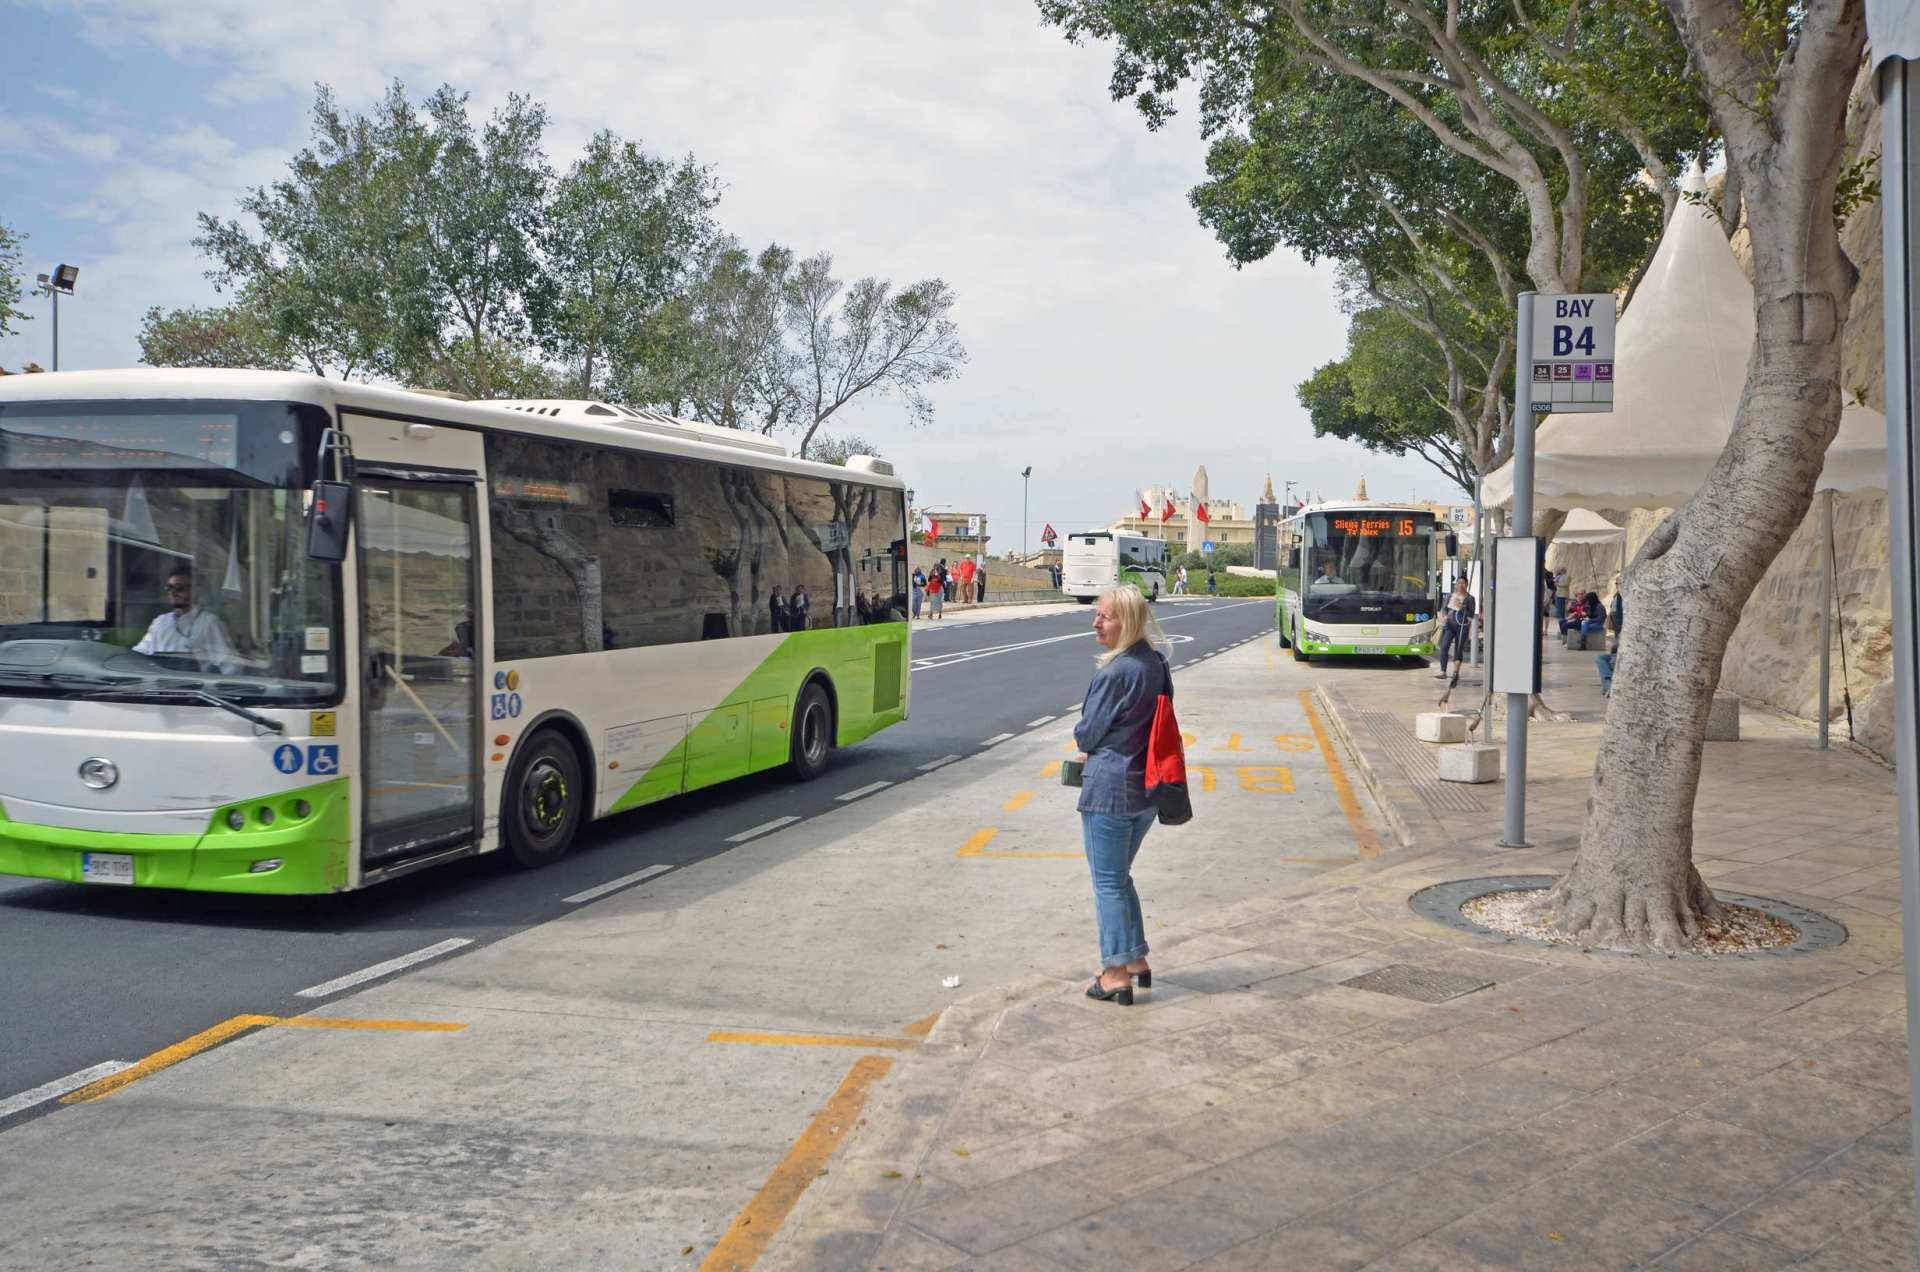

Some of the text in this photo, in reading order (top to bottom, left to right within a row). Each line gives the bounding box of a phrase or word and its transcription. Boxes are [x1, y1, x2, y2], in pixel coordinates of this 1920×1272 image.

[1555, 298, 1595, 319] BAY
[1552, 324, 1596, 357] B4
[1557, 366, 1568, 374] 25
[1532, 404, 1551, 412] 6306
[1361, 519, 1391, 529] Ferries
[1398, 519, 1414, 537] 15
